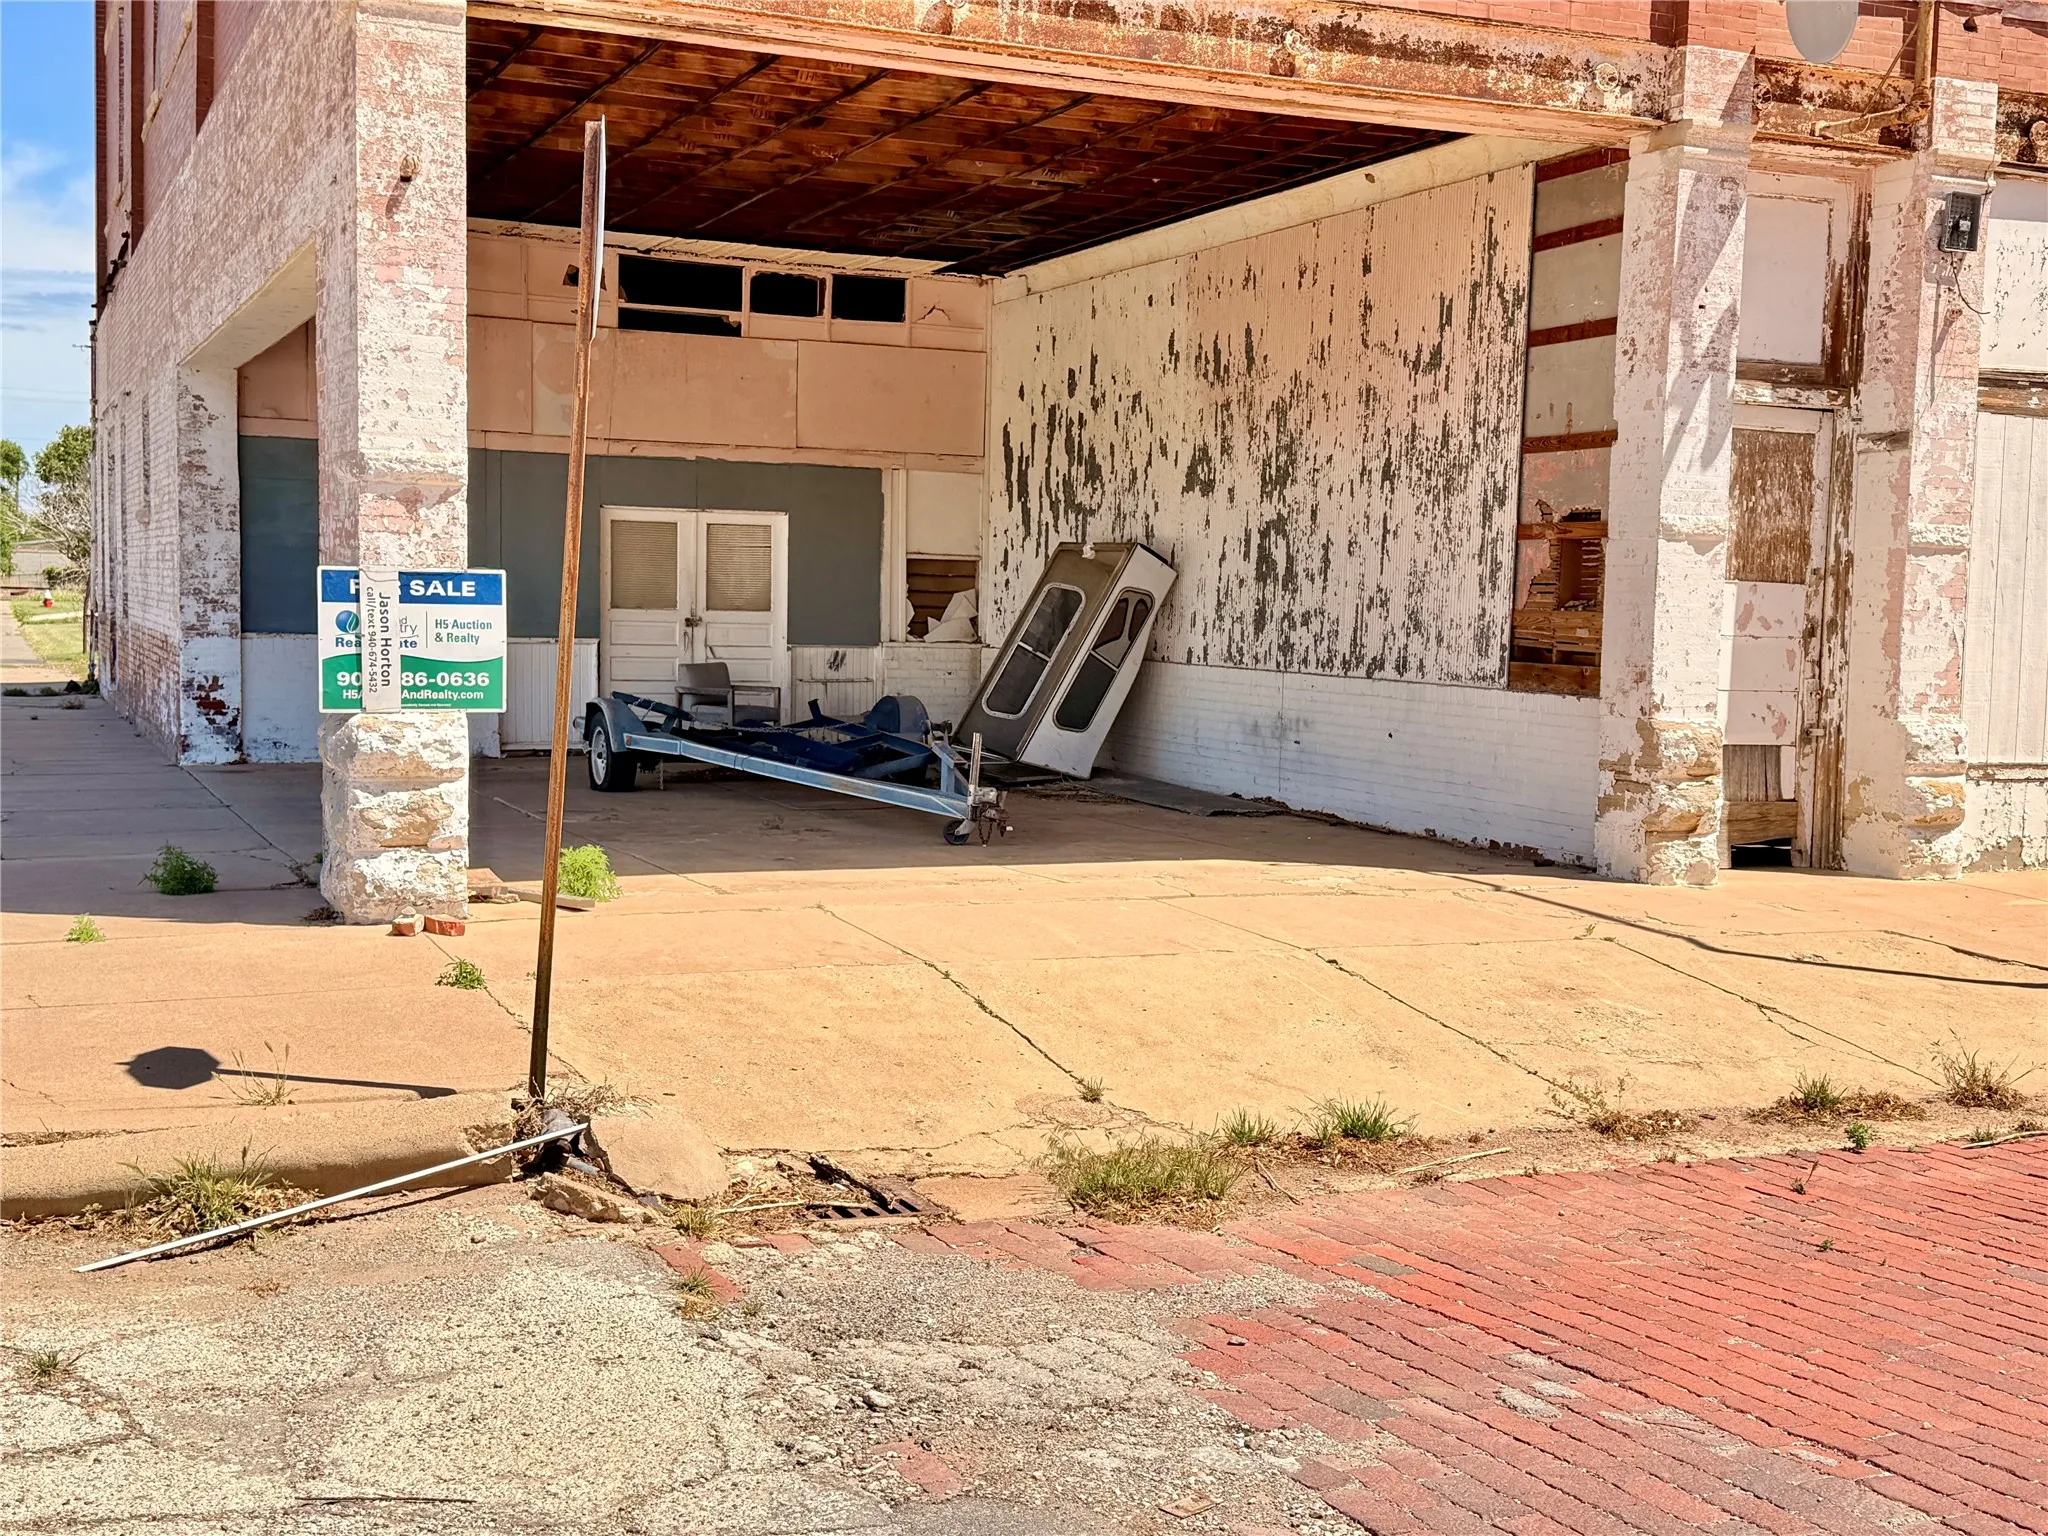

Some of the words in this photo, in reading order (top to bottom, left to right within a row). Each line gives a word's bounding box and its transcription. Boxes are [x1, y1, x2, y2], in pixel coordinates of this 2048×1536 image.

[409, 580, 476, 597] SALE
[366, 586, 377, 629] call/text
[379, 592, 391, 633] Jason
[435, 618, 449, 630] H5
[451, 619, 492, 630] Auction
[335, 637, 361, 648] Rea
[434, 632, 444, 643] &
[446, 633, 480, 646] Realty
[368, 631, 378, 693] 940-674-5432
[381, 637, 392, 687] Horton
